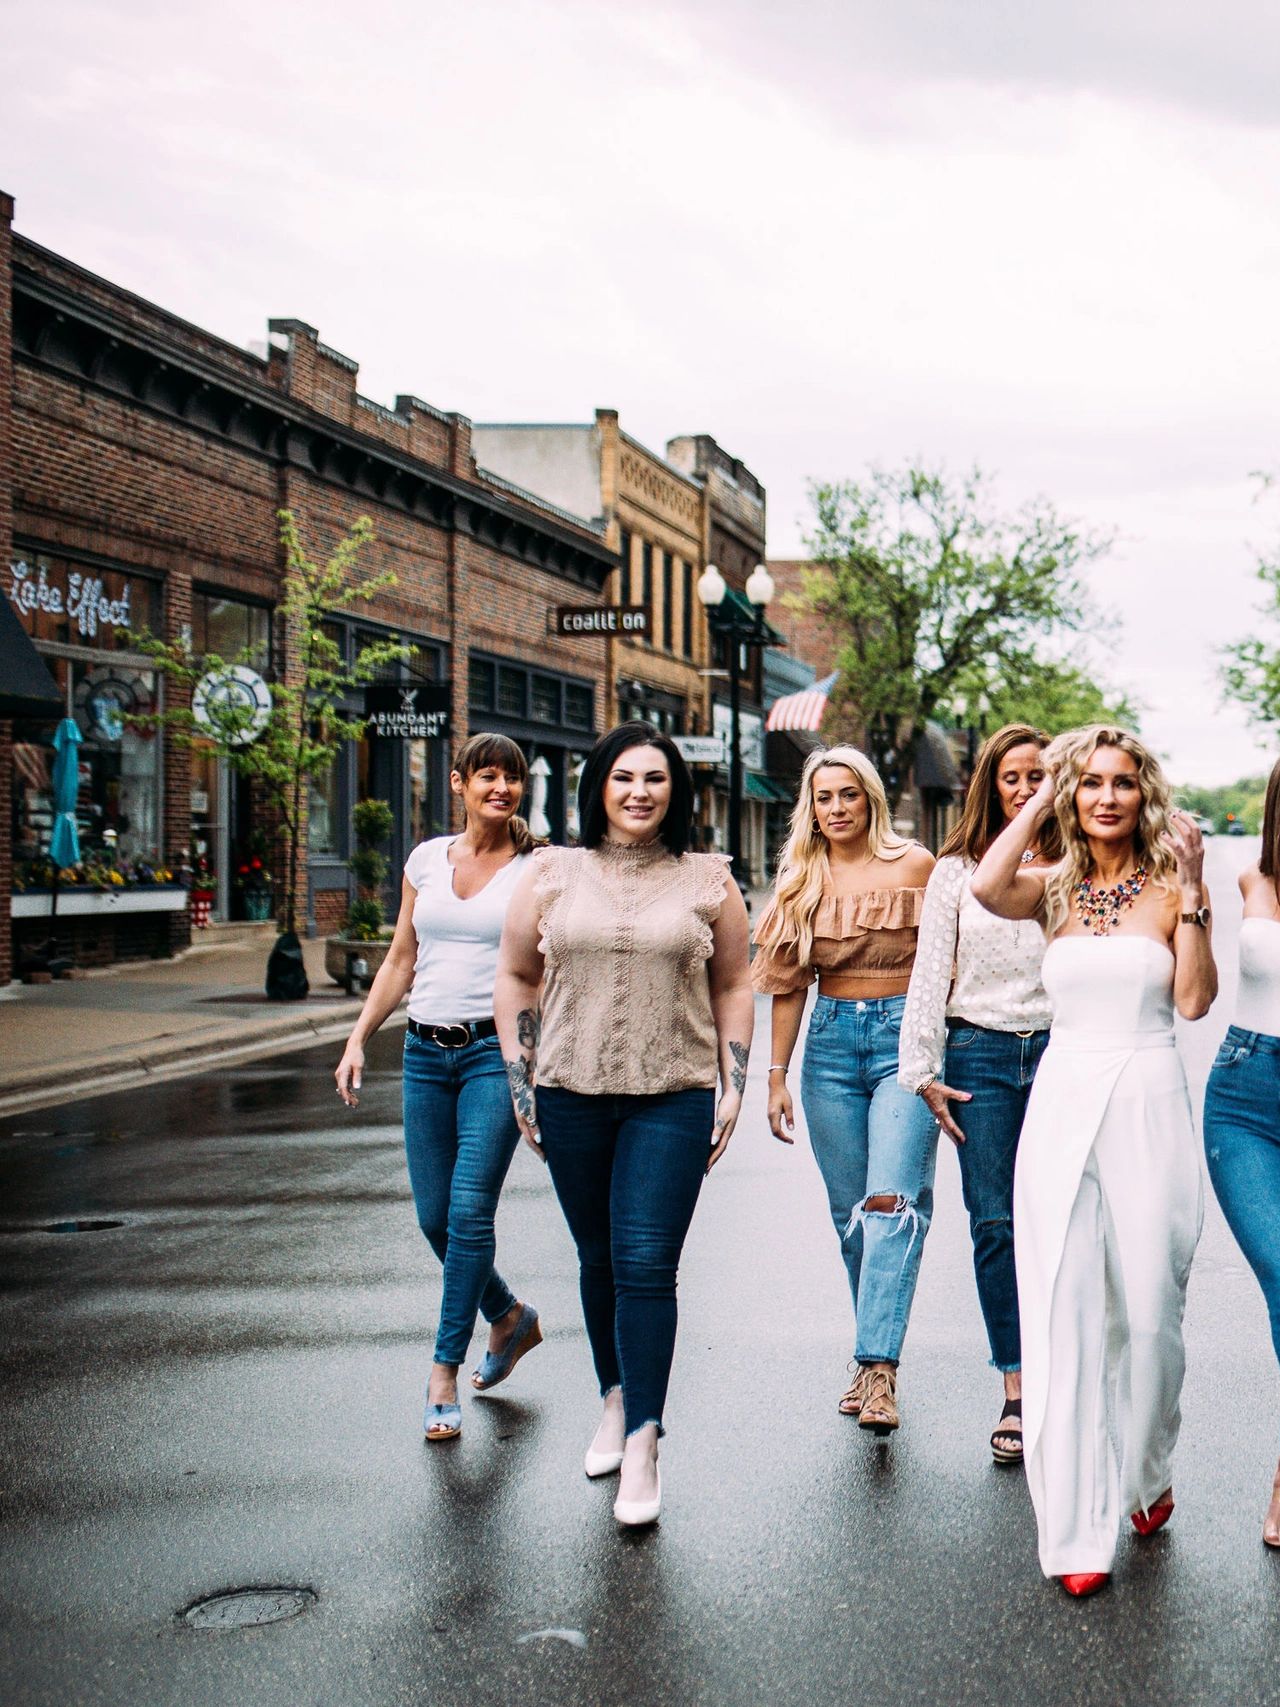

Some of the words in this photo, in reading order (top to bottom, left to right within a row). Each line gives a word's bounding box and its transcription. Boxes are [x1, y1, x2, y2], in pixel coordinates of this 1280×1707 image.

[67, 572, 131, 637] Effect
[368, 711, 447, 725] ABUNDANT
[376, 723, 439, 737] KITCHEN
